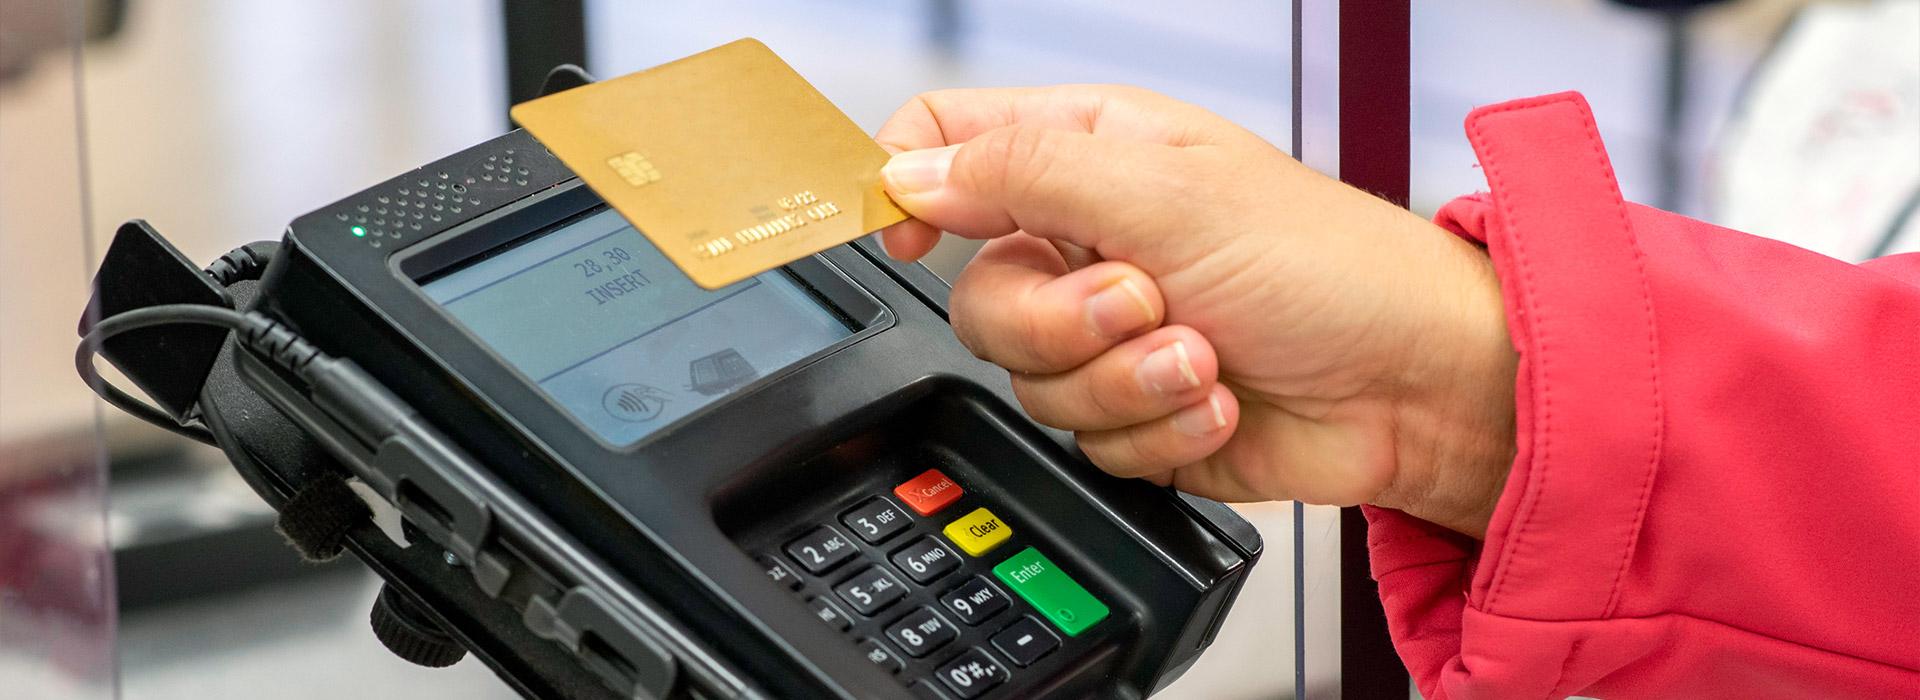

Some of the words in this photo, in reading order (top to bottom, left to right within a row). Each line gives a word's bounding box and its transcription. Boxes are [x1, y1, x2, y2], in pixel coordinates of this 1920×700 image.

[574, 247, 631, 277] 28,30
[585, 268, 651, 304] INSERT
[922, 478, 952, 497] Cancel
[857, 517, 878, 535] 3
[876, 509, 896, 524] DEF
[969, 519, 1000, 538] Clear
[802, 546, 825, 563] 2
[822, 536, 846, 553] ABC
[907, 556, 926, 573] 6
[920, 547, 946, 565] MNO
[1009, 561, 1045, 584] Enter
[850, 586, 872, 605] 5
[953, 598, 973, 615] 9
[969, 587, 994, 605] WXY
[901, 628, 924, 646] 8
[918, 617, 942, 635] TUV
